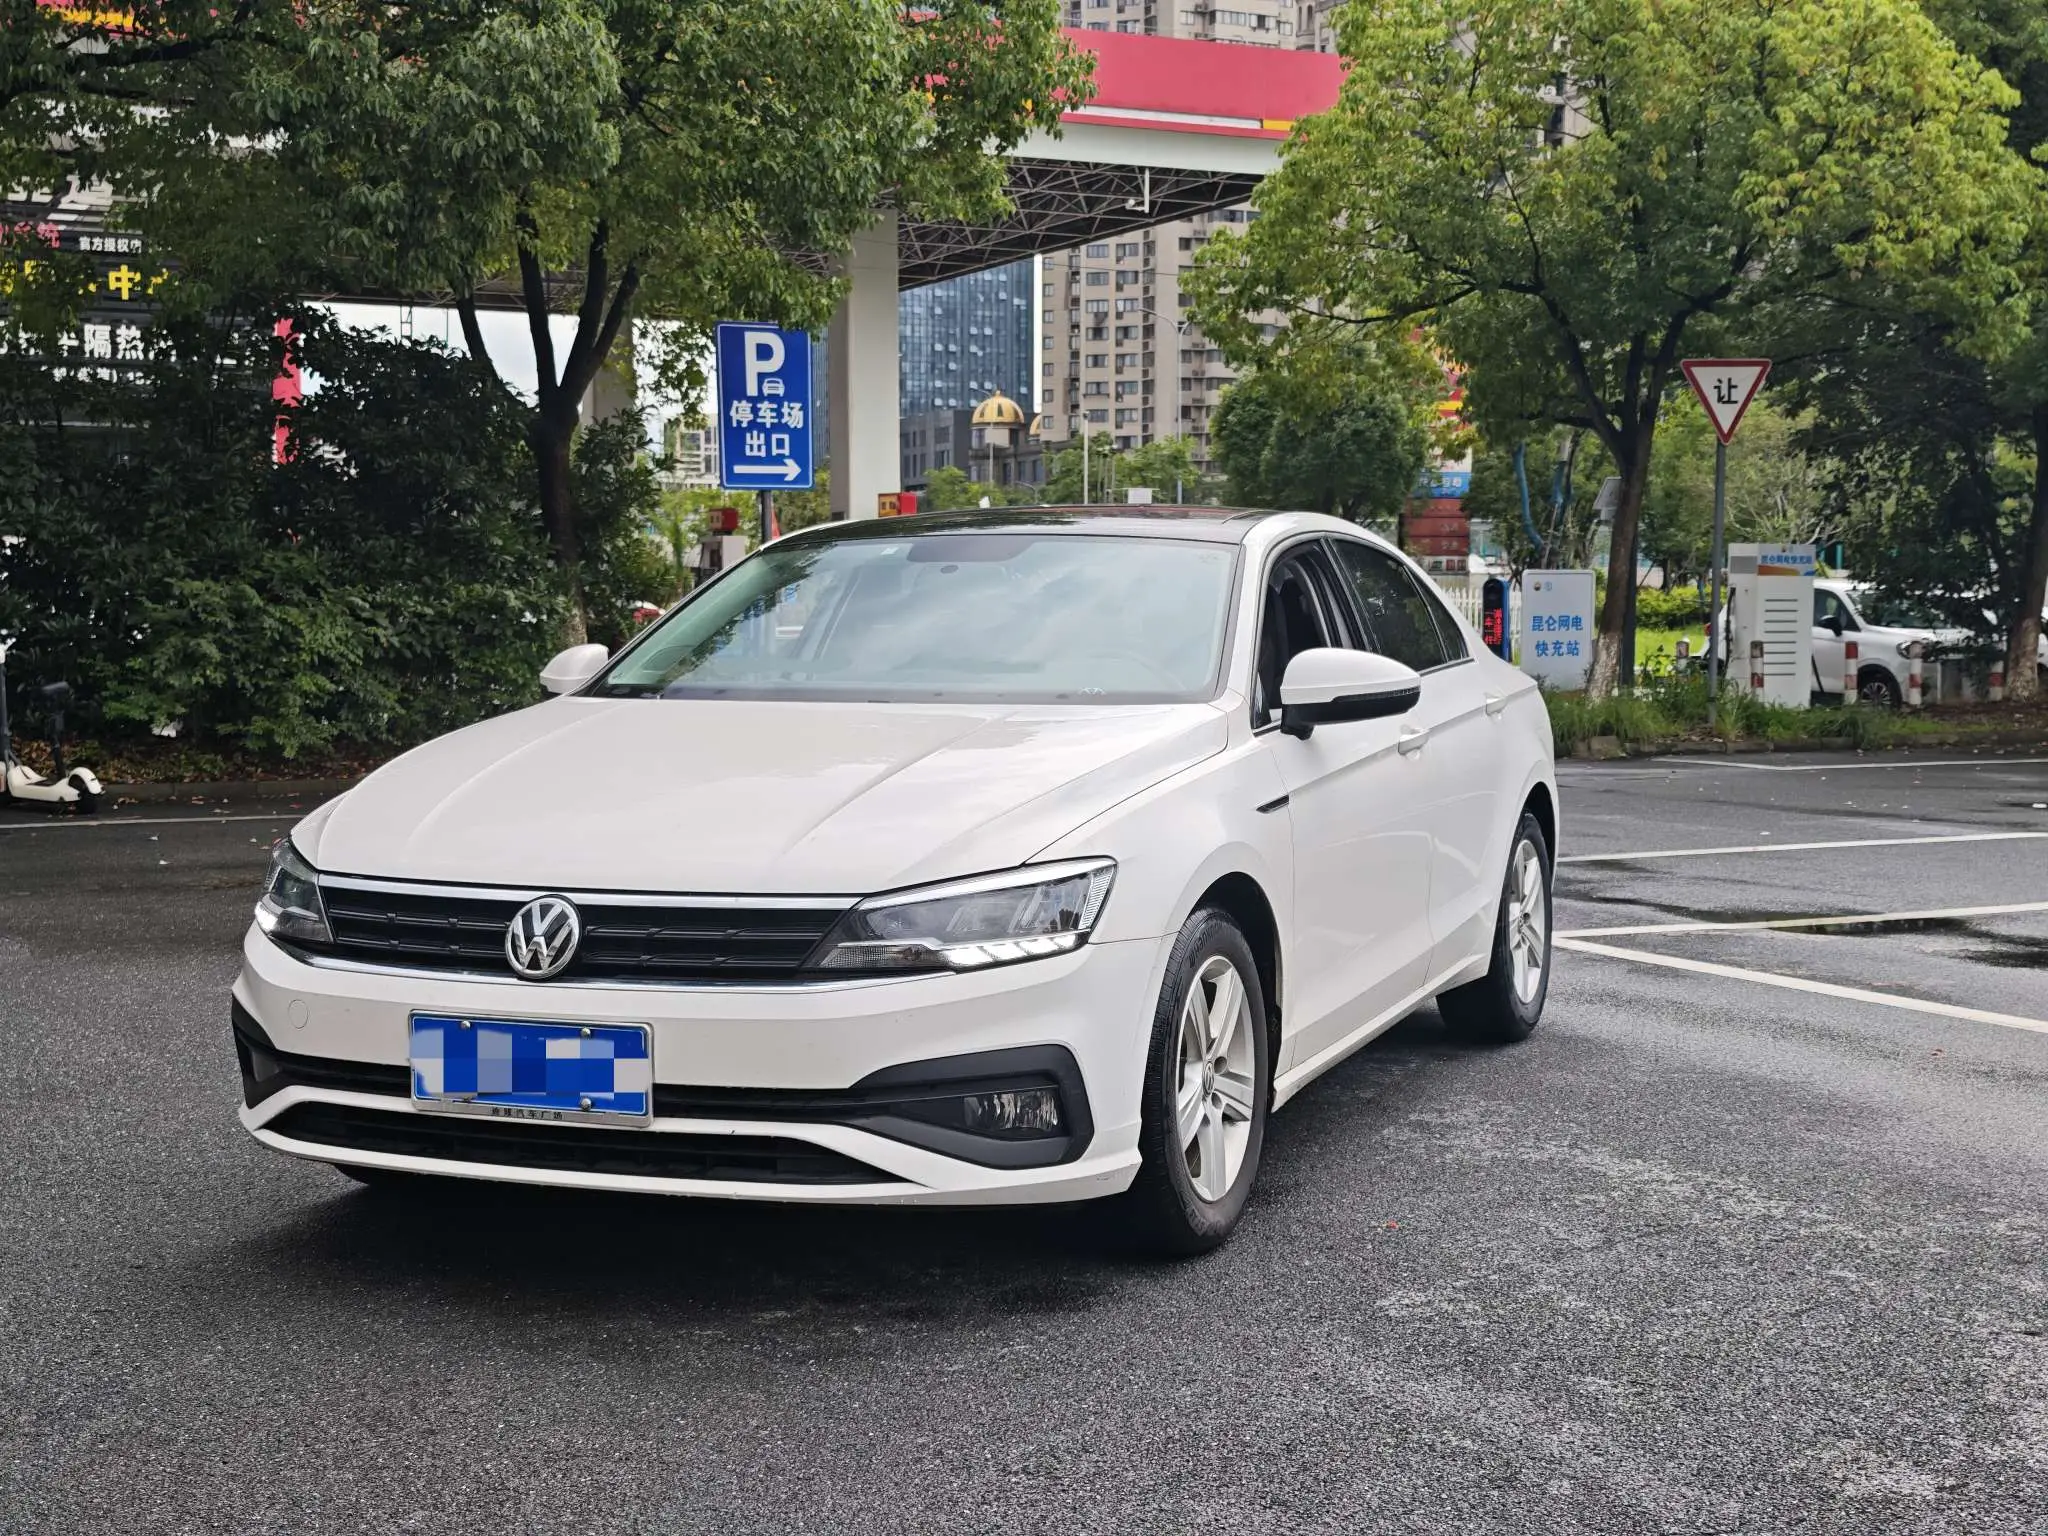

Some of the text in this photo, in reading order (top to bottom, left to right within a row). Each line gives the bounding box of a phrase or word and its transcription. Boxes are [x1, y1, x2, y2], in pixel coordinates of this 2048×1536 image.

[744, 331, 785, 396] P
[1713, 377, 1738, 404] 让
[730, 400, 804, 428] 停车场
[745, 430, 790, 457] 出口
[1531, 615, 1584, 631] 昆仑网电
[1535, 640, 1580, 657] 快充站
